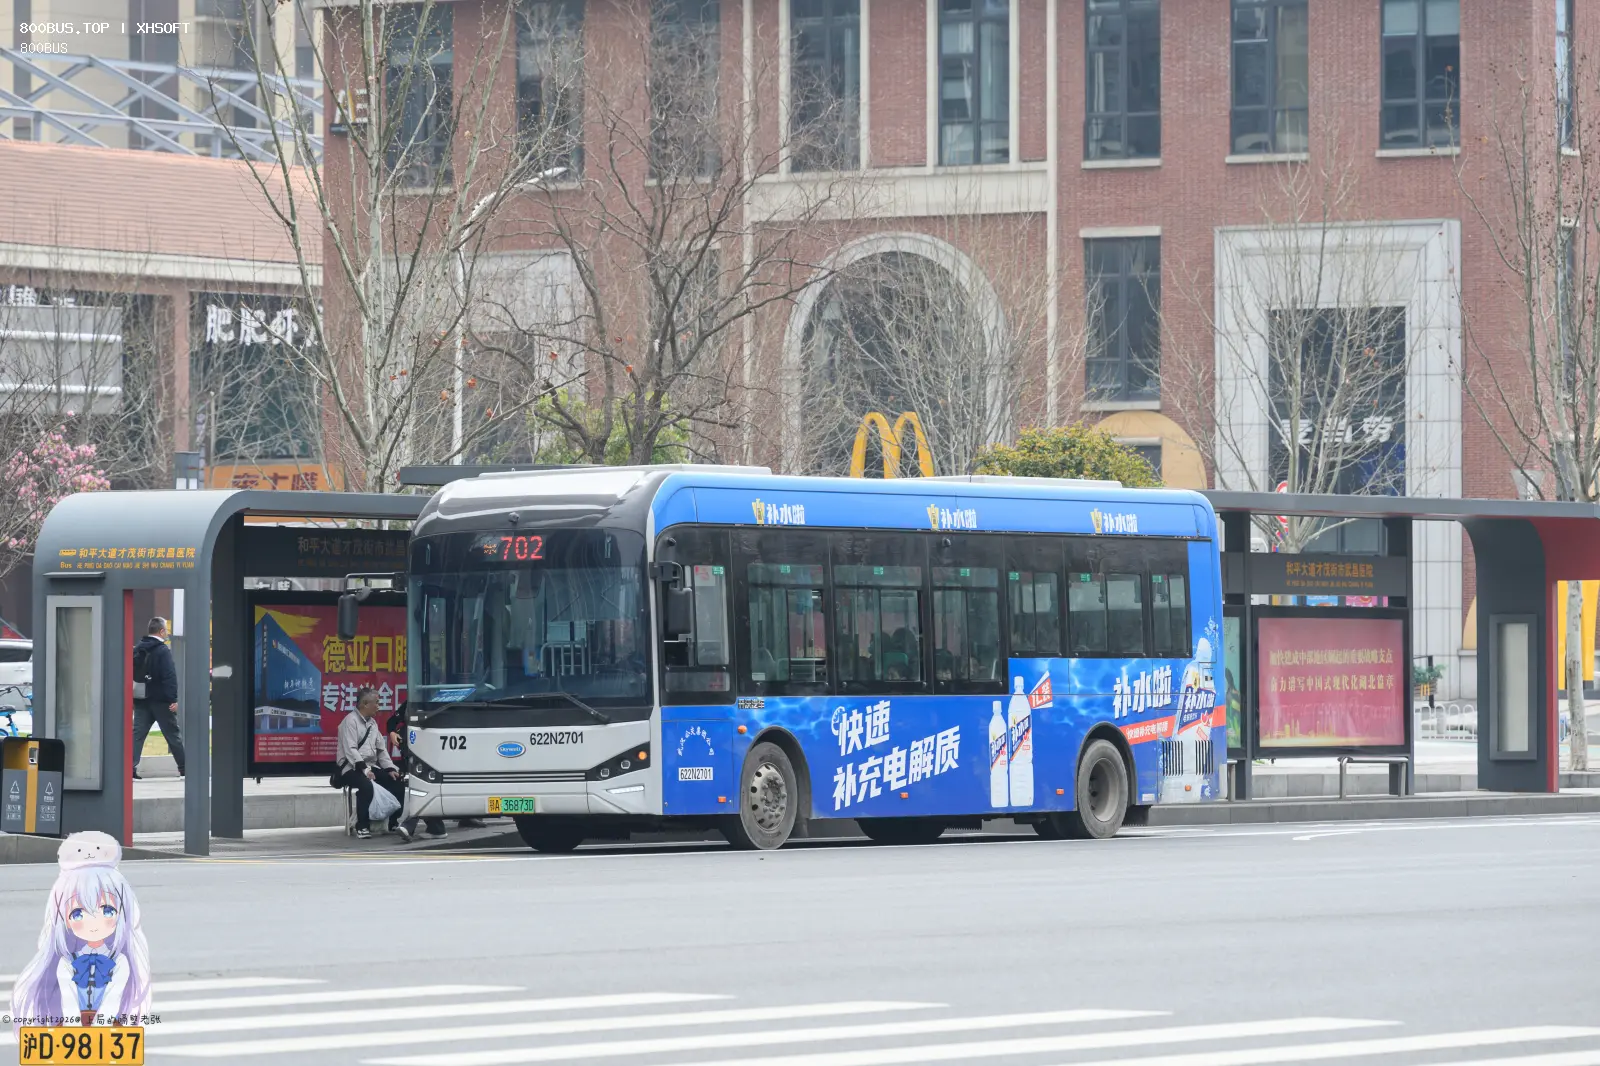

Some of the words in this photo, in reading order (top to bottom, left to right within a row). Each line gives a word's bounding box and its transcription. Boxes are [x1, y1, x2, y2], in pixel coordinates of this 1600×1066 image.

[206, 304, 324, 348] 肥肥虾
[766, 503, 806, 525] 补水啦
[940, 508, 978, 529] 补水啦
[1102, 512, 1139, 533] 补水啦
[79, 547, 196, 559] 和平大道才茂街市武昌医院
[501, 535, 543, 560] 702
[60, 561, 73, 569] Bus
[1286, 561, 1374, 578] 和平大道才茂街市武昌医院
[1112, 665, 1172, 719] 补水啦
[1270, 674, 1394, 692] 奋力谱写中国式现代化湖北篇章
[1184, 686, 1216, 713] 补水啦
[529, 731, 584, 746] 622N2701
[835, 700, 891, 757] 快速
[439, 735, 467, 750] 702
[680, 768, 712, 780] 622N2701
[832, 725, 961, 811] 补充电解质
